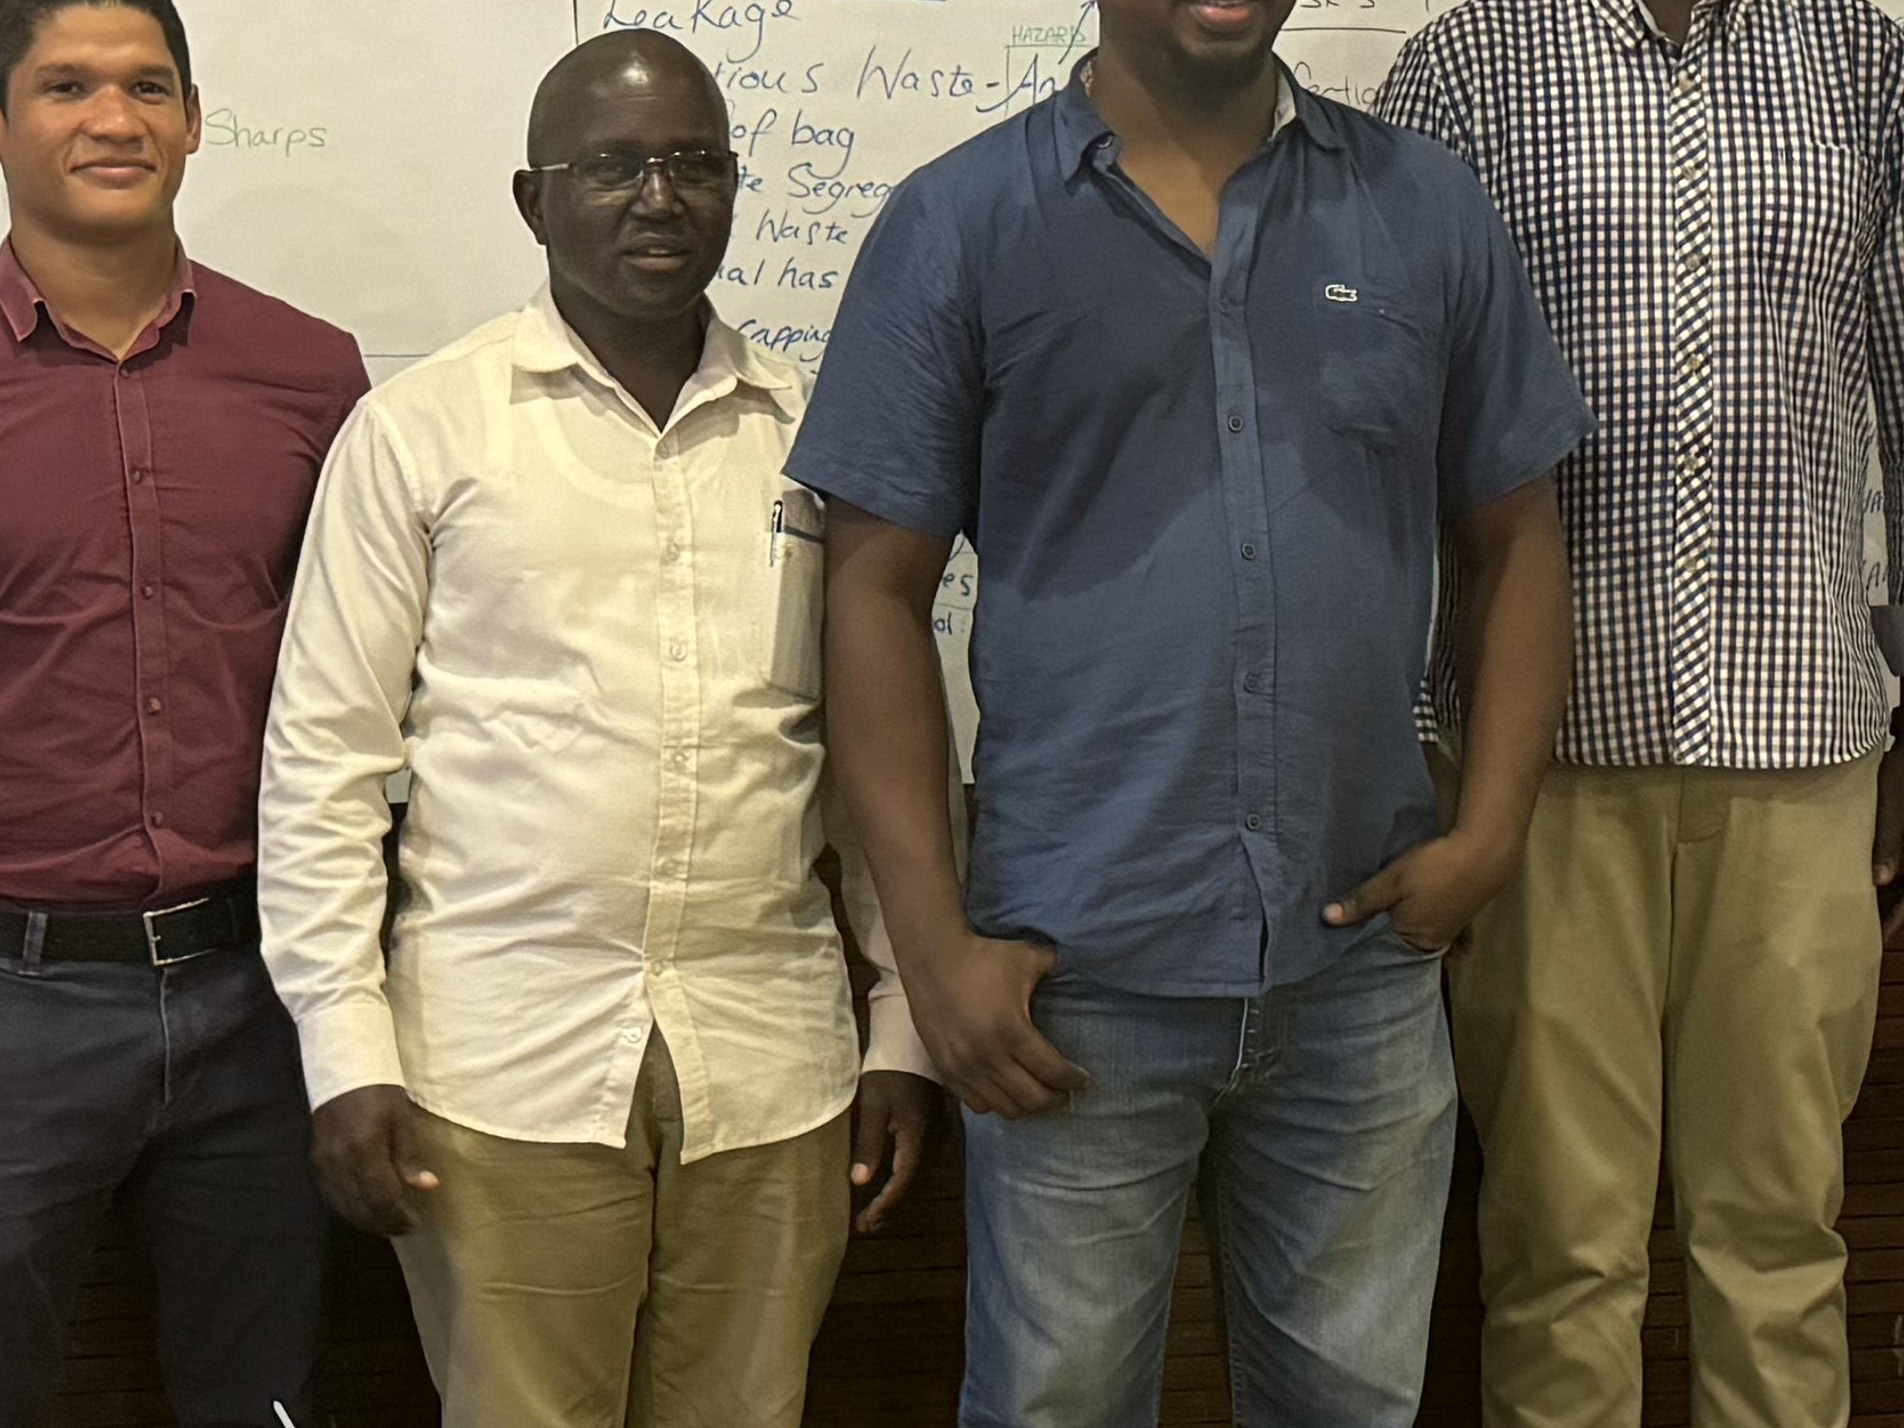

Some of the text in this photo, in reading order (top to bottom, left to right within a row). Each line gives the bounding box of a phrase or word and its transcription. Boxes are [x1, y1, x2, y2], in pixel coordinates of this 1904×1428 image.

[202, 107, 328, 157] Sharps
[791, 108, 855, 181] bag
[787, 161, 897, 218] Segreg
[755, 209, 849, 246] Waste
[776, 256, 840, 291] has
